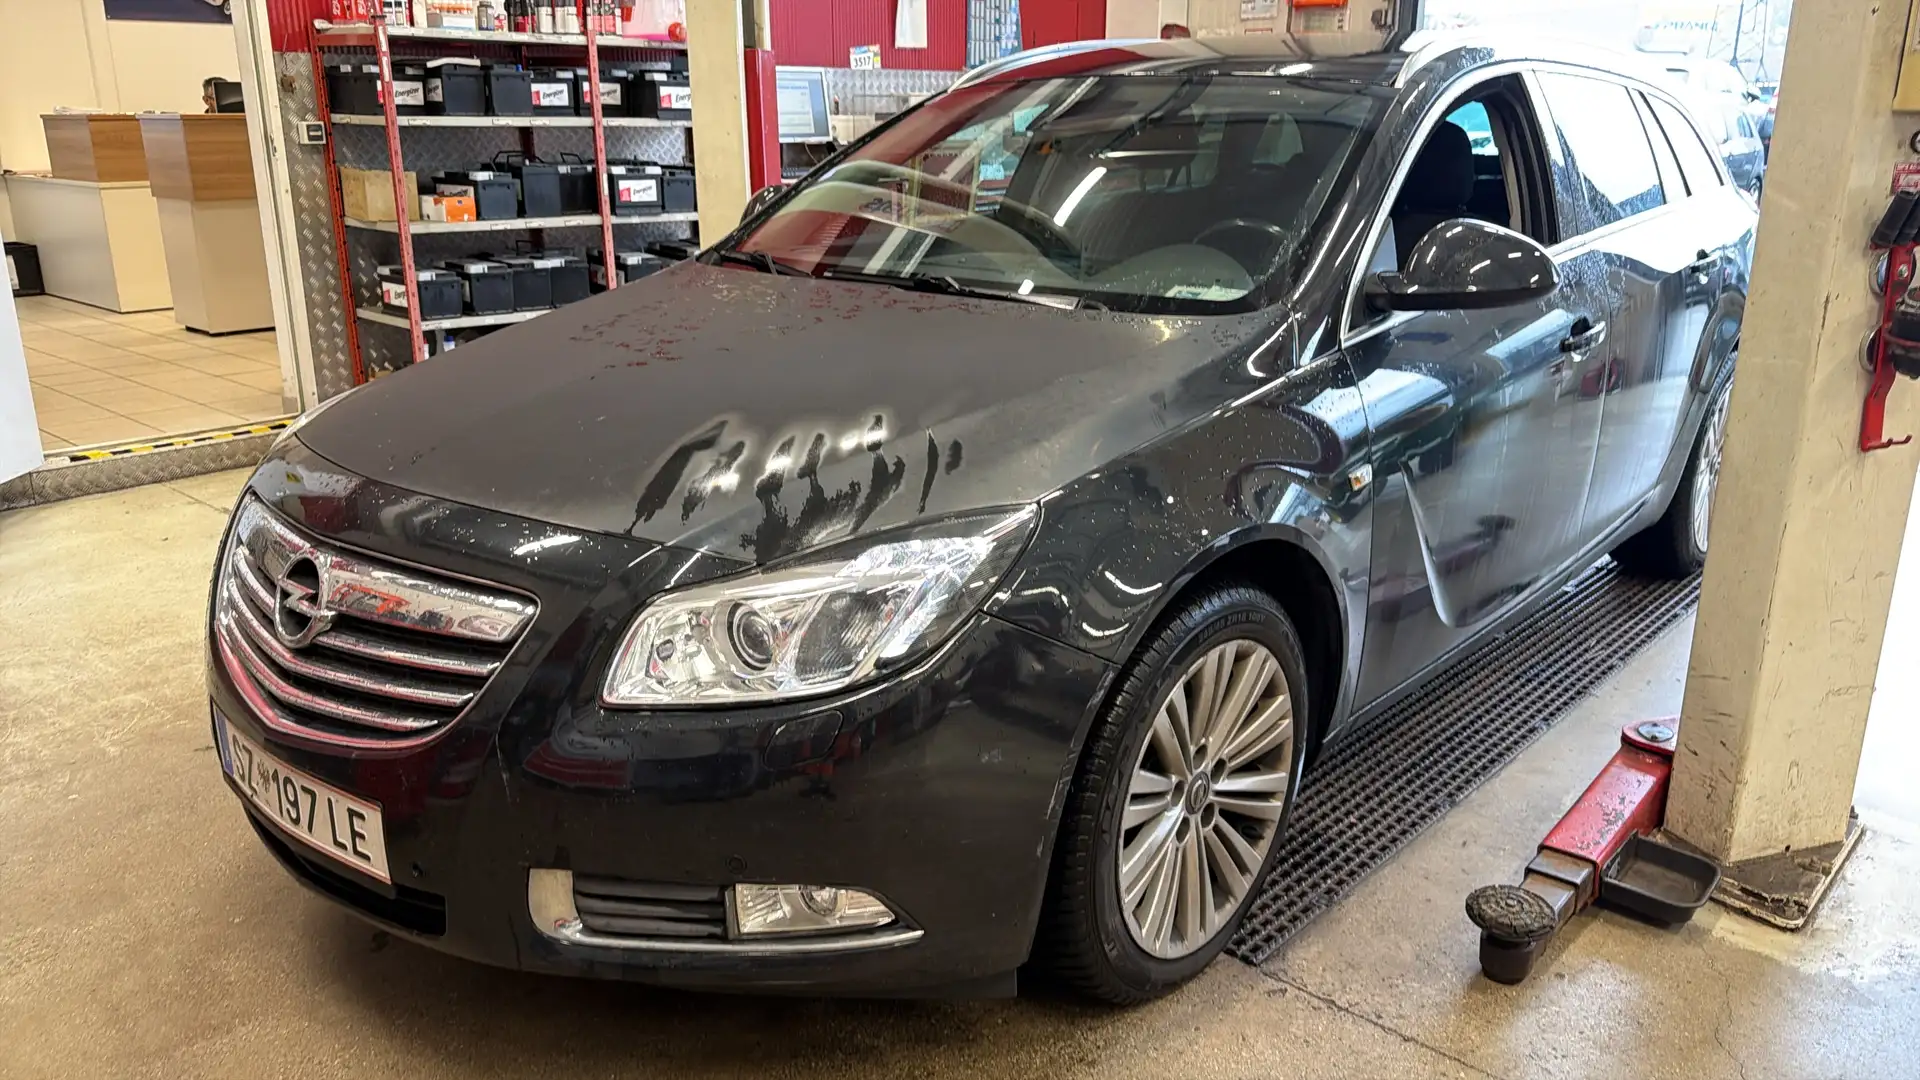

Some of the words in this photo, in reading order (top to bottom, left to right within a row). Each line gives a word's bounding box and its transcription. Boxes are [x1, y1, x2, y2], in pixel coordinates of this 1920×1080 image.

[853, 55, 872, 68] 3517
[394, 87, 420, 98] Energizer
[542, 88, 565, 100] Energizer
[633, 185, 653, 196] Energizer
[232, 734, 258, 797] SZ
[271, 767, 317, 834] 197
[327, 796, 372, 863] LE
